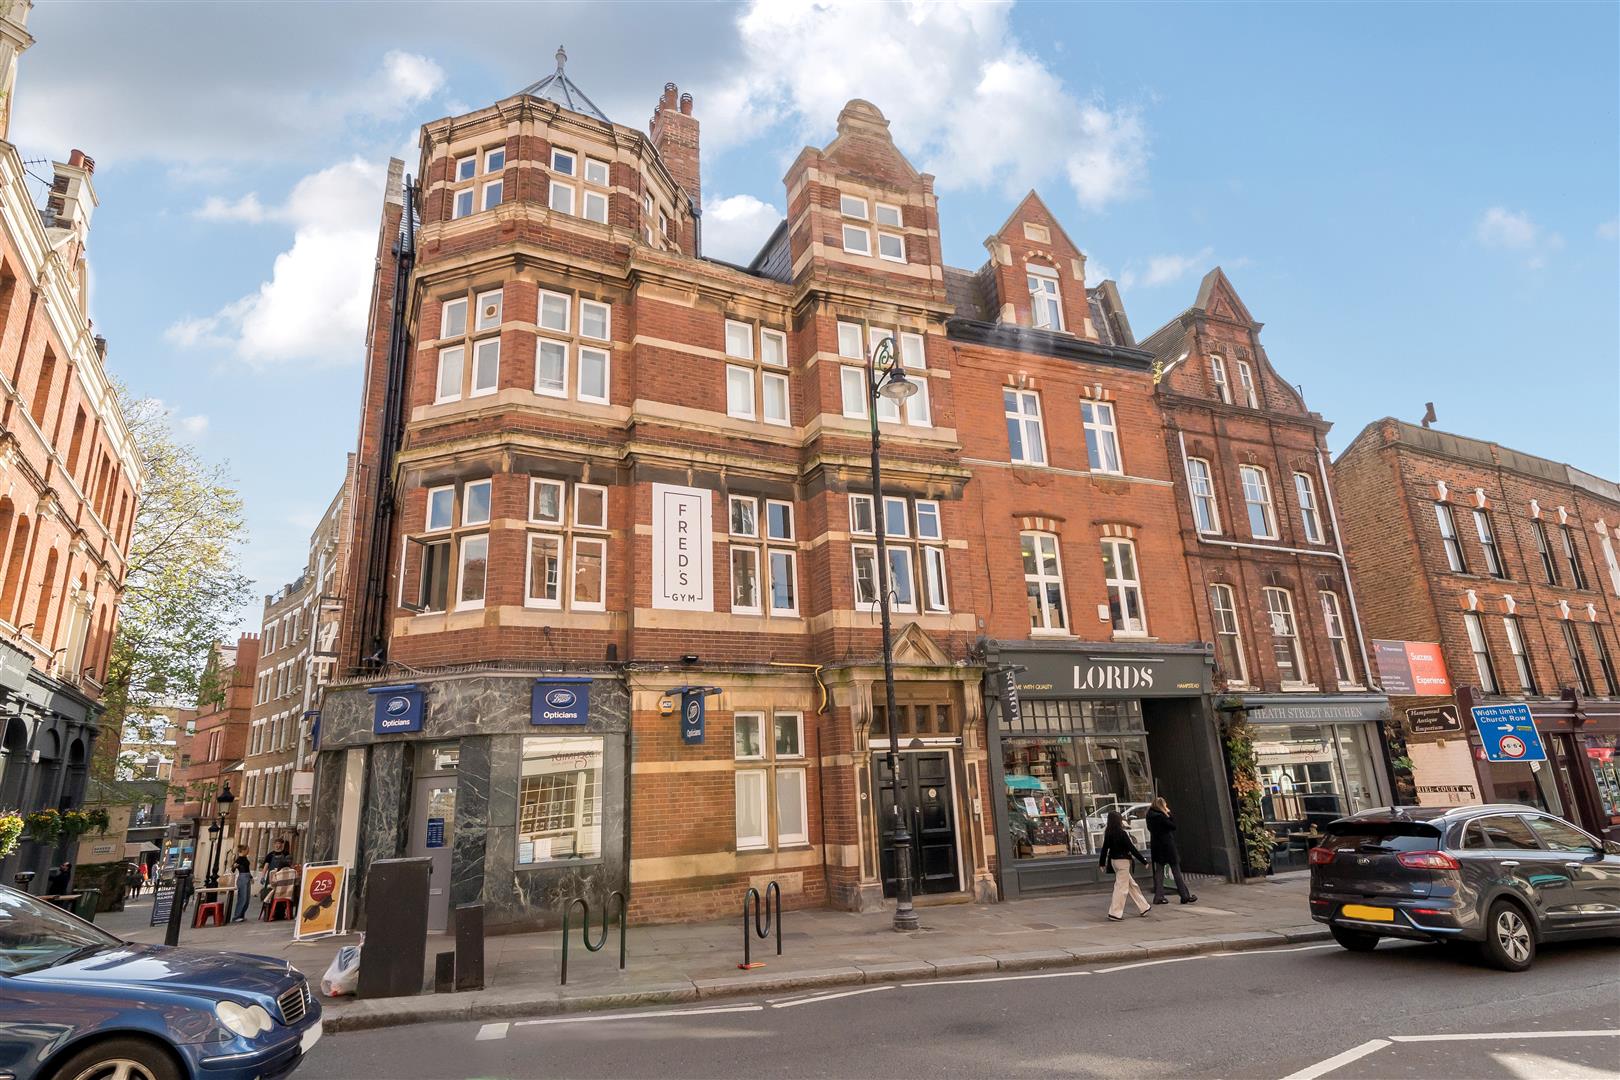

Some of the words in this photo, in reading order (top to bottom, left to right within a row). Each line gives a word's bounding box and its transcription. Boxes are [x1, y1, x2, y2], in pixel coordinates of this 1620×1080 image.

[678, 504, 689, 586] FRED'S
[672, 593, 695, 602] GYM
[1410, 652, 1433, 661] Success
[1073, 665, 1153, 689] LORDS
[1415, 676, 1446, 685] Experience
[552, 693, 572, 704] Boots
[1005, 671, 1020, 721] LORDS
[543, 711, 578, 719] Opticians
[1254, 707, 1286, 719] HEATH
[1288, 707, 1322, 718] STREET
[1324, 706, 1362, 718] KITCHEN
[1411, 708, 1440, 716] Hampstead
[382, 719, 410, 728] Opticians
[1480, 715, 1507, 723] Church
[313, 879, 333, 892] 25%
